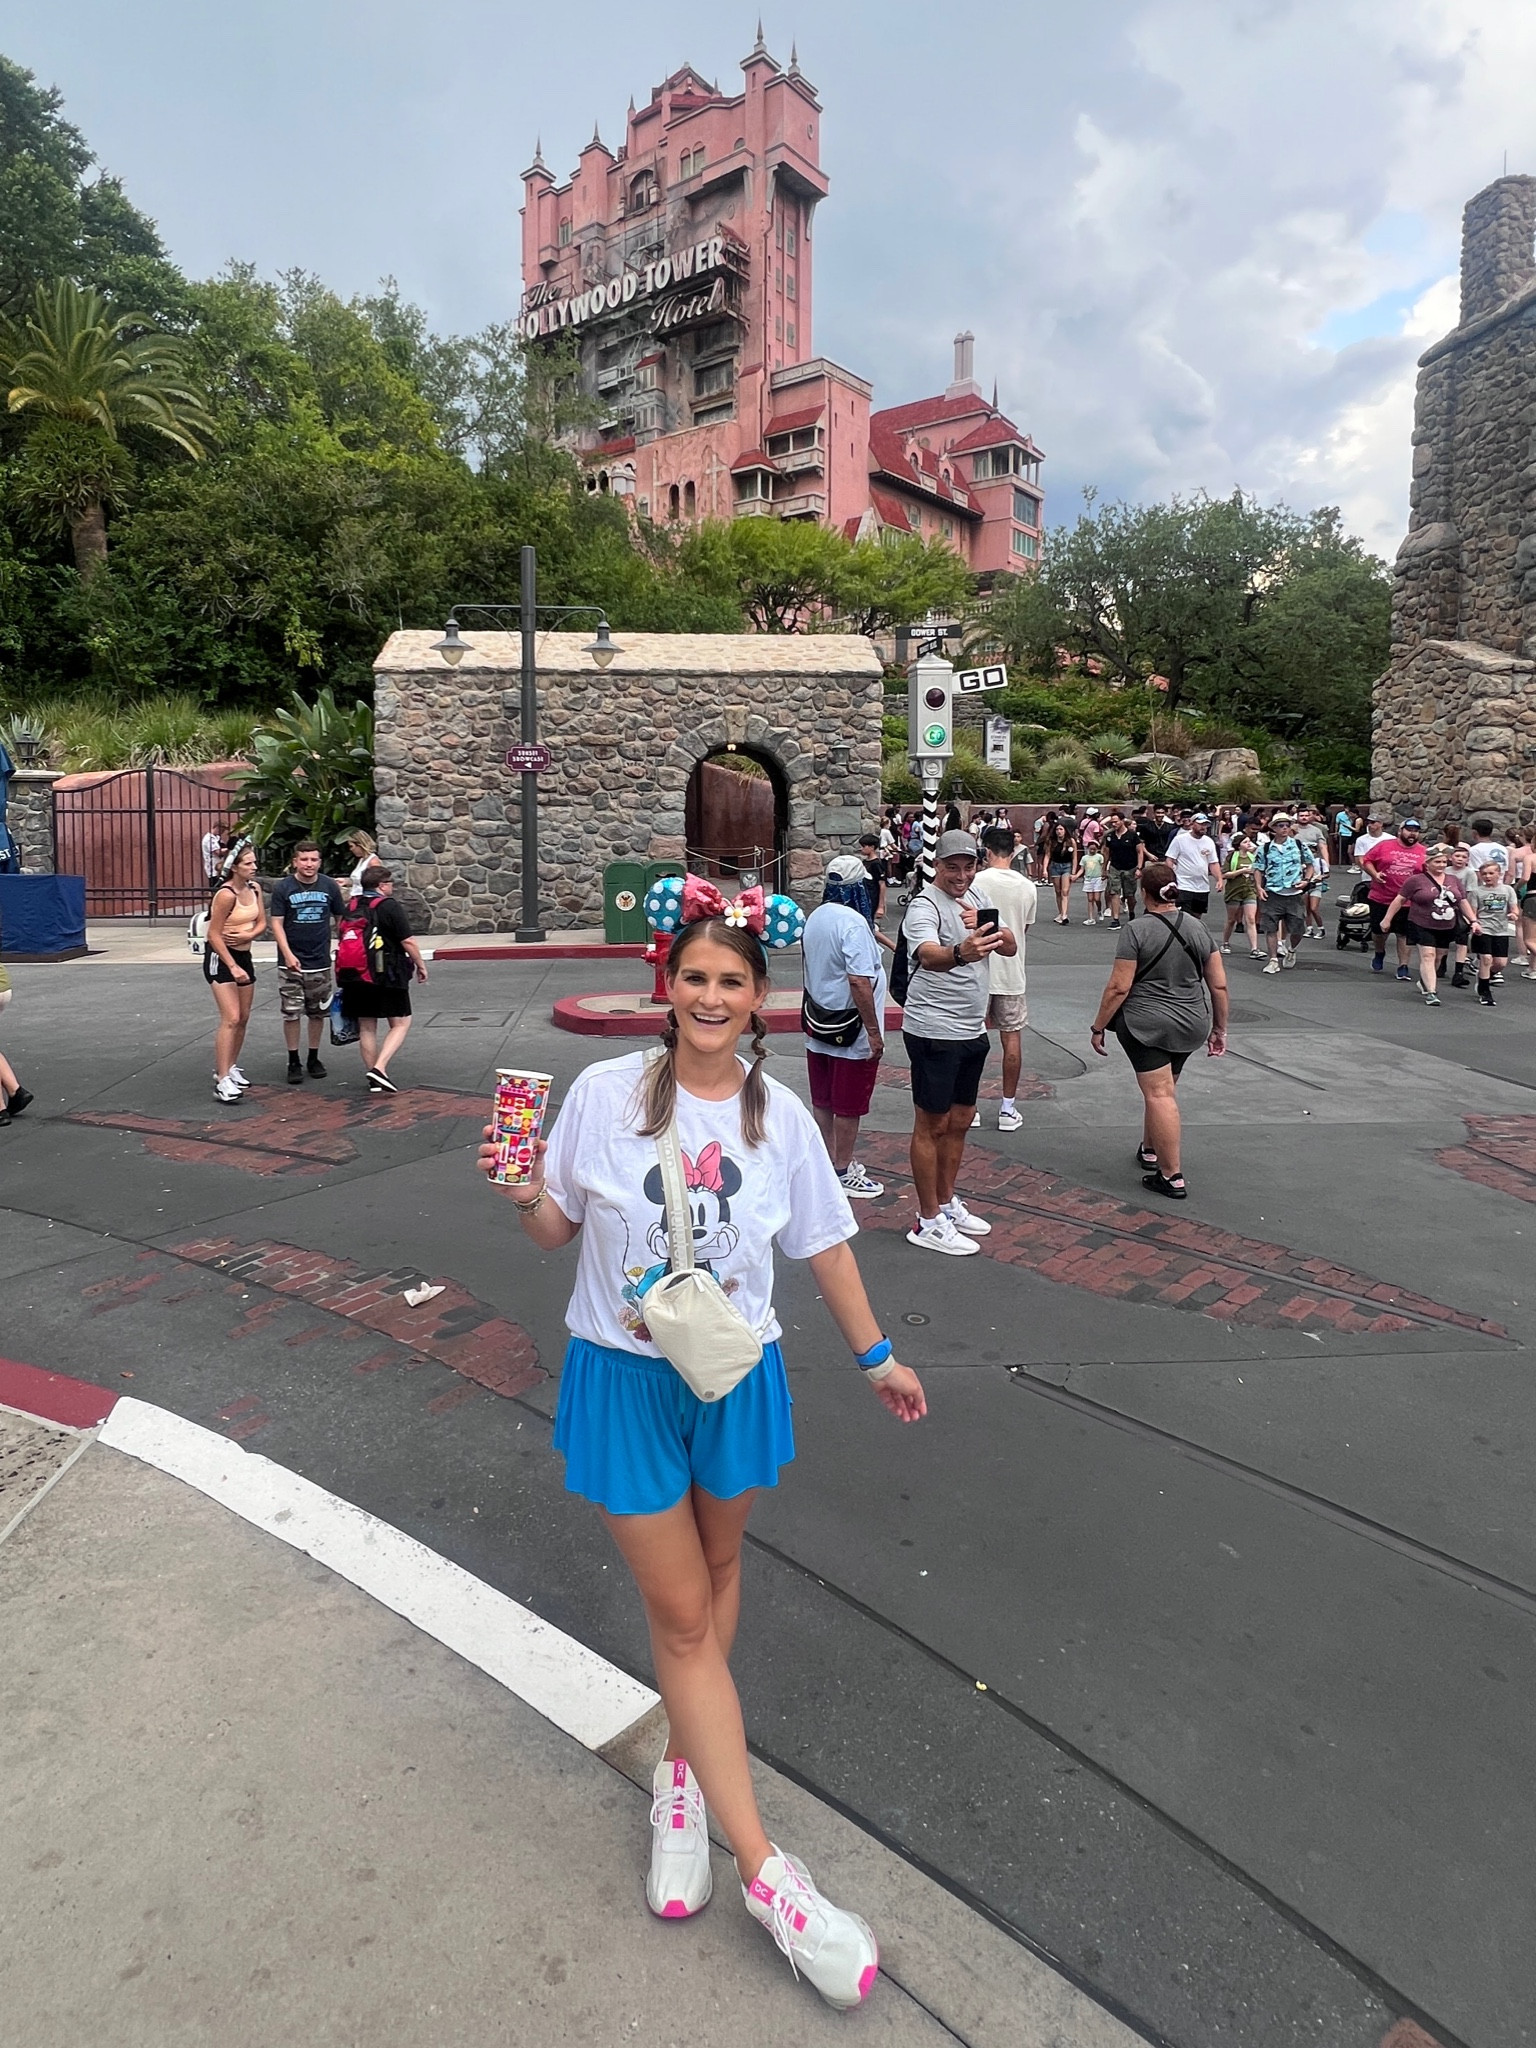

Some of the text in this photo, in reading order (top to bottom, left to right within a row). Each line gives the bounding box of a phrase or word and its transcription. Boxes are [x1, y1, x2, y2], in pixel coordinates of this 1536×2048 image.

[514, 235, 726, 342] HOLLYWOOD TOWER
[527, 281, 558, 308] The
[648, 277, 726, 334] Hotel
[959, 667, 1004, 691] GO
